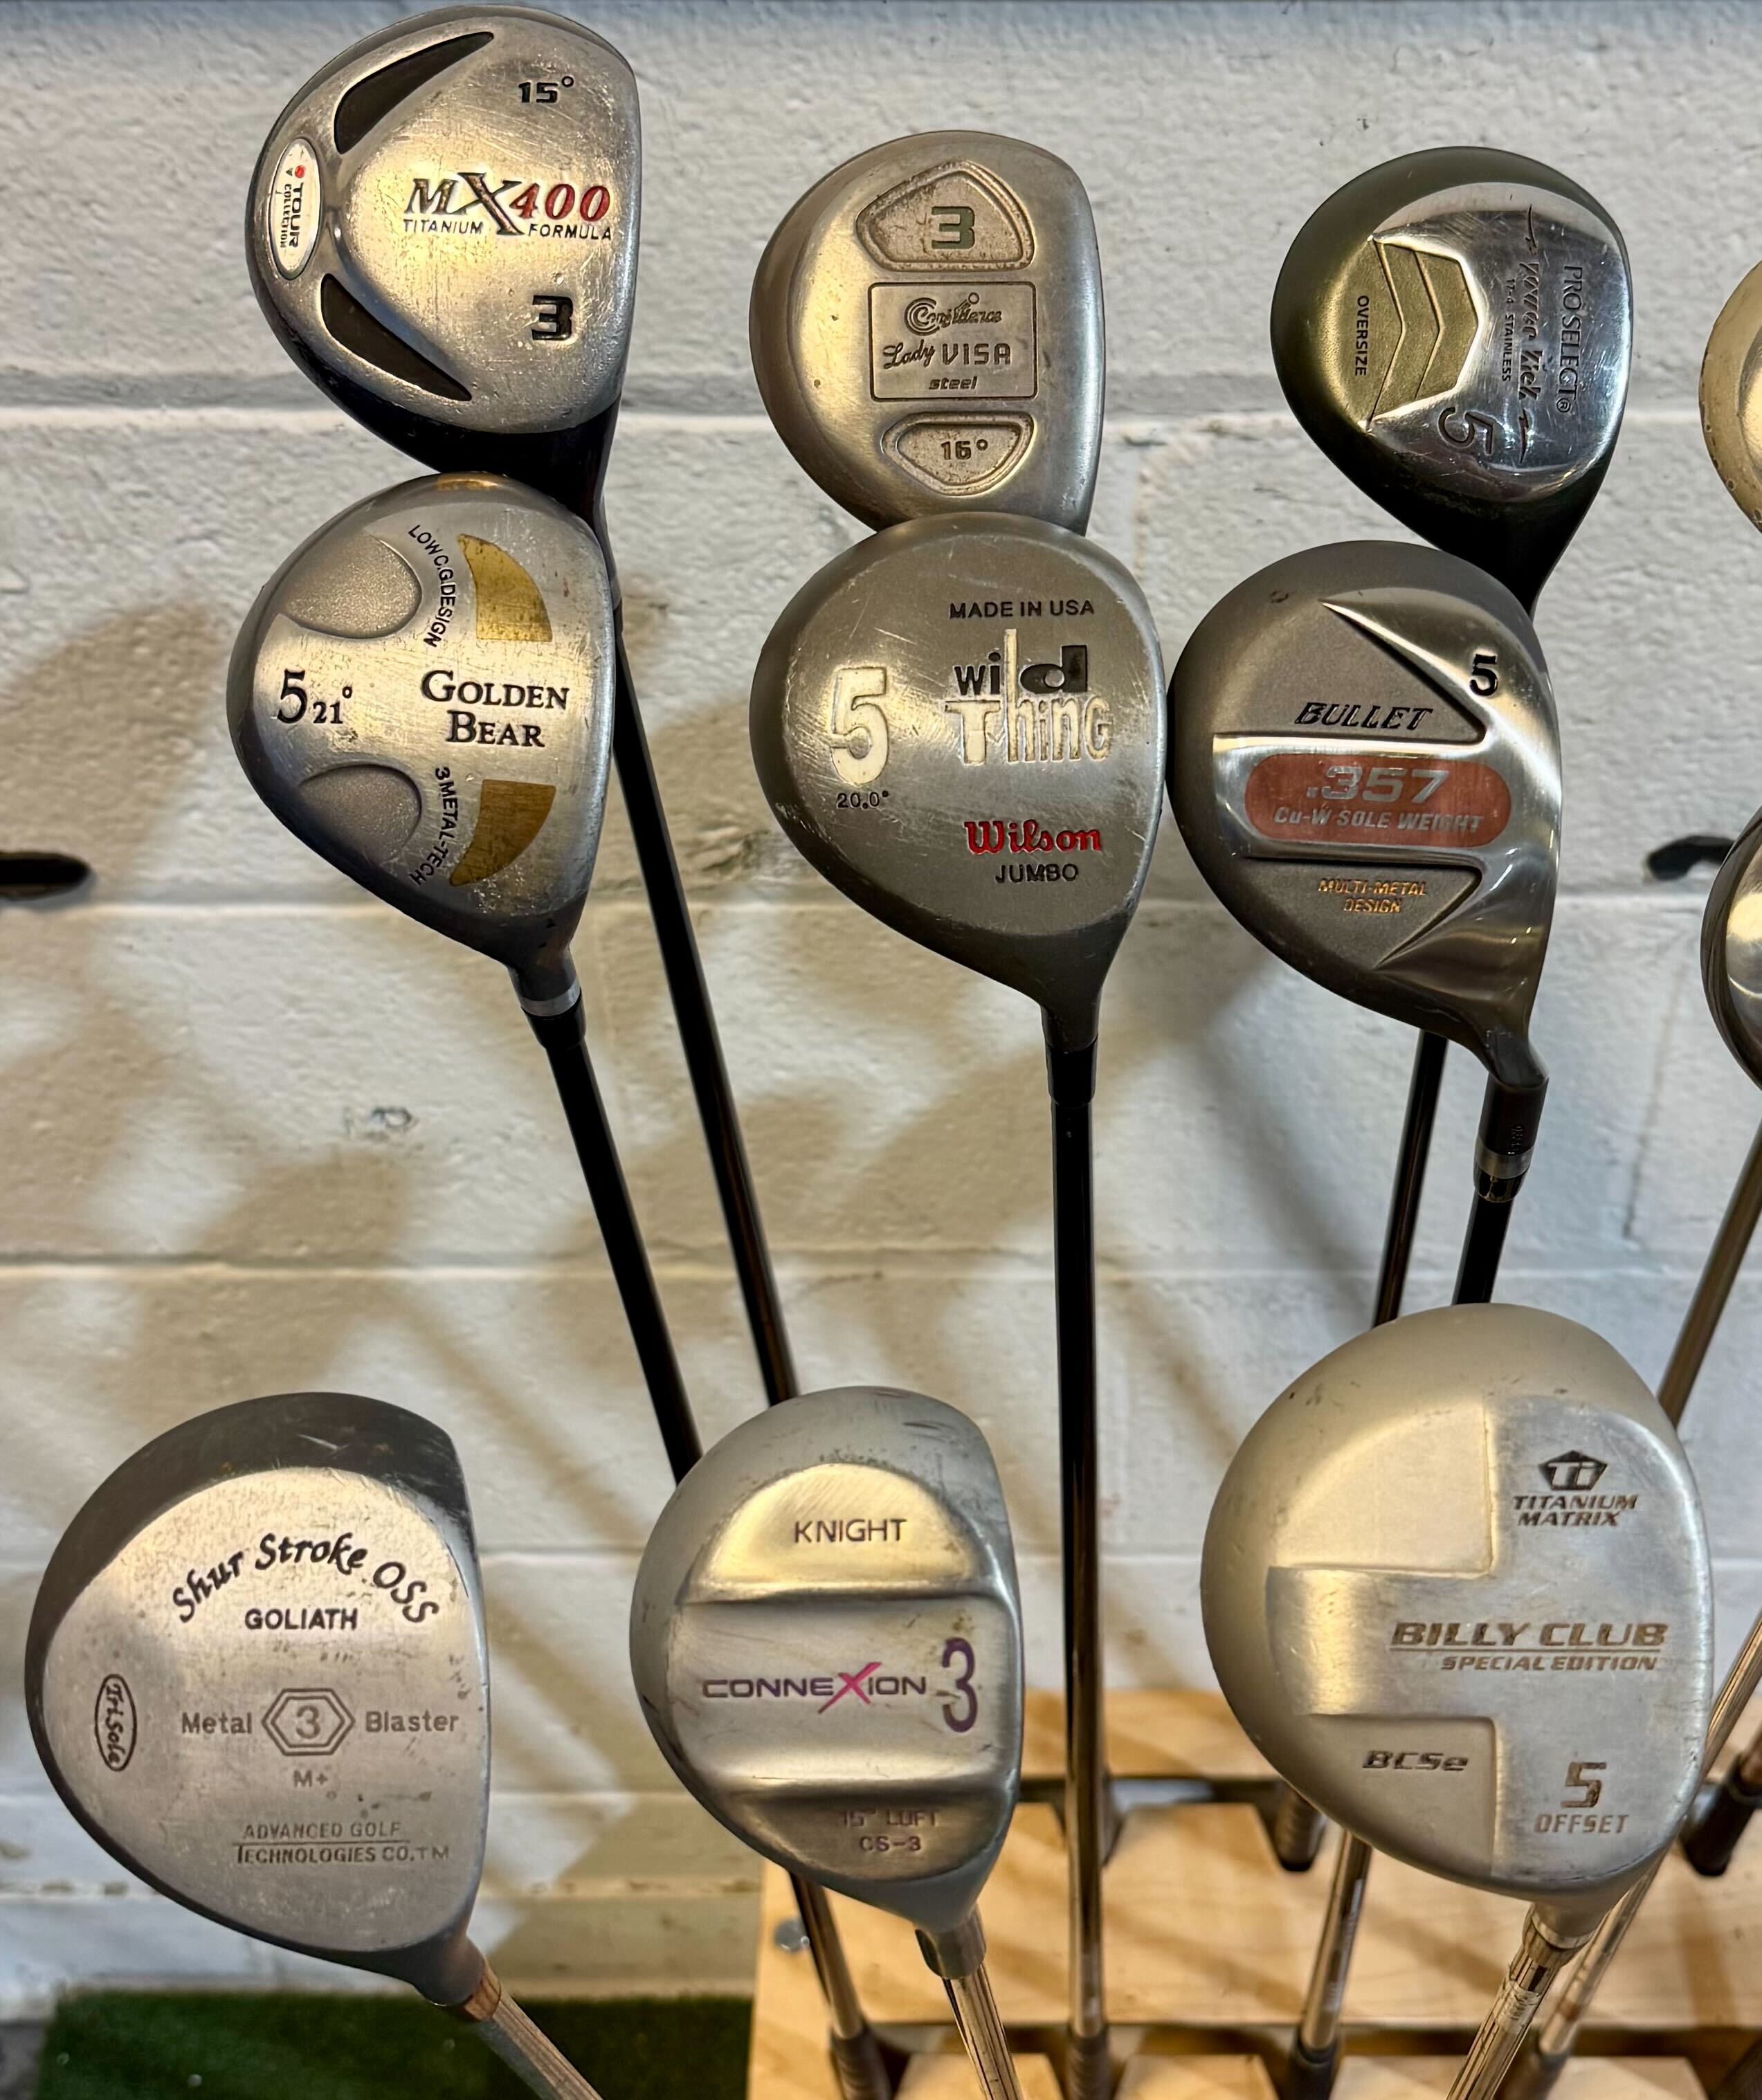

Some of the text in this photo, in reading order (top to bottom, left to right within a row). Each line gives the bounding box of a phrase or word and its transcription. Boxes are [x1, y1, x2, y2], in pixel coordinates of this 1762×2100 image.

[518, 76, 574, 103] 15°
[289, 182, 304, 248] TOUR
[404, 172, 610, 235] MX400
[403, 219, 484, 234] TITANIUM
[528, 223, 612, 241] FORMULA
[931, 206, 974, 249] 3
[531, 295, 574, 341] 3
[1501, 278, 1516, 382] 17-4 STAINLESS
[1354, 295, 1370, 376] OVERSIZE
[882, 339, 1011, 369] Lady VISA
[928, 376, 978, 390] steel
[1438, 406, 1494, 455] 5
[408, 524, 443, 555] LOW
[423, 584, 456, 648] DESIGN
[950, 601, 1094, 619] MADE IN USA
[954, 629, 1088, 696] wild
[1470, 655, 1499, 696] 5
[277, 670, 352, 724] 5 21°
[830, 666, 889, 784] 5
[1294, 702, 1434, 731] BULLET
[1307, 765, 1449, 803] .357
[837, 791, 890, 808] 20.0°
[1336, 810, 1392, 829] SOLE
[1397, 813, 1484, 834] WEIGHT
[964, 821, 1102, 855] Wilson
[995, 864, 1079, 883] JUMBO
[1318, 877, 1426, 897] MULTI-METAL
[1343, 898, 1402, 914] DESIGN
[1514, 1495, 1638, 1510] TITANIUM
[794, 1519, 907, 1543] KNIGHT
[1517, 1510, 1619, 1526] MATRIX
[172, 1531, 439, 1623] Shur Stroke OSS
[244, 1607, 358, 1630] GOLIATH
[1390, 1622, 1669, 1647] BILLY CLUB
[1441, 1656, 1657, 1671] SPECIAL EDITION
[941, 1636, 978, 1733] 3
[181, 1705, 460, 1740] Metal 3 Blaster
[1362, 1750, 1469, 1771] BCSe
[1561, 1761, 1607, 1808] 5
[243, 1822, 401, 1839] ADVANCED GOLF
[1534, 1813, 1630, 1835] OFFSET
[237, 1845, 376, 1864] TECHNOLOGIES
[860, 1836, 921, 1852] CS-3
